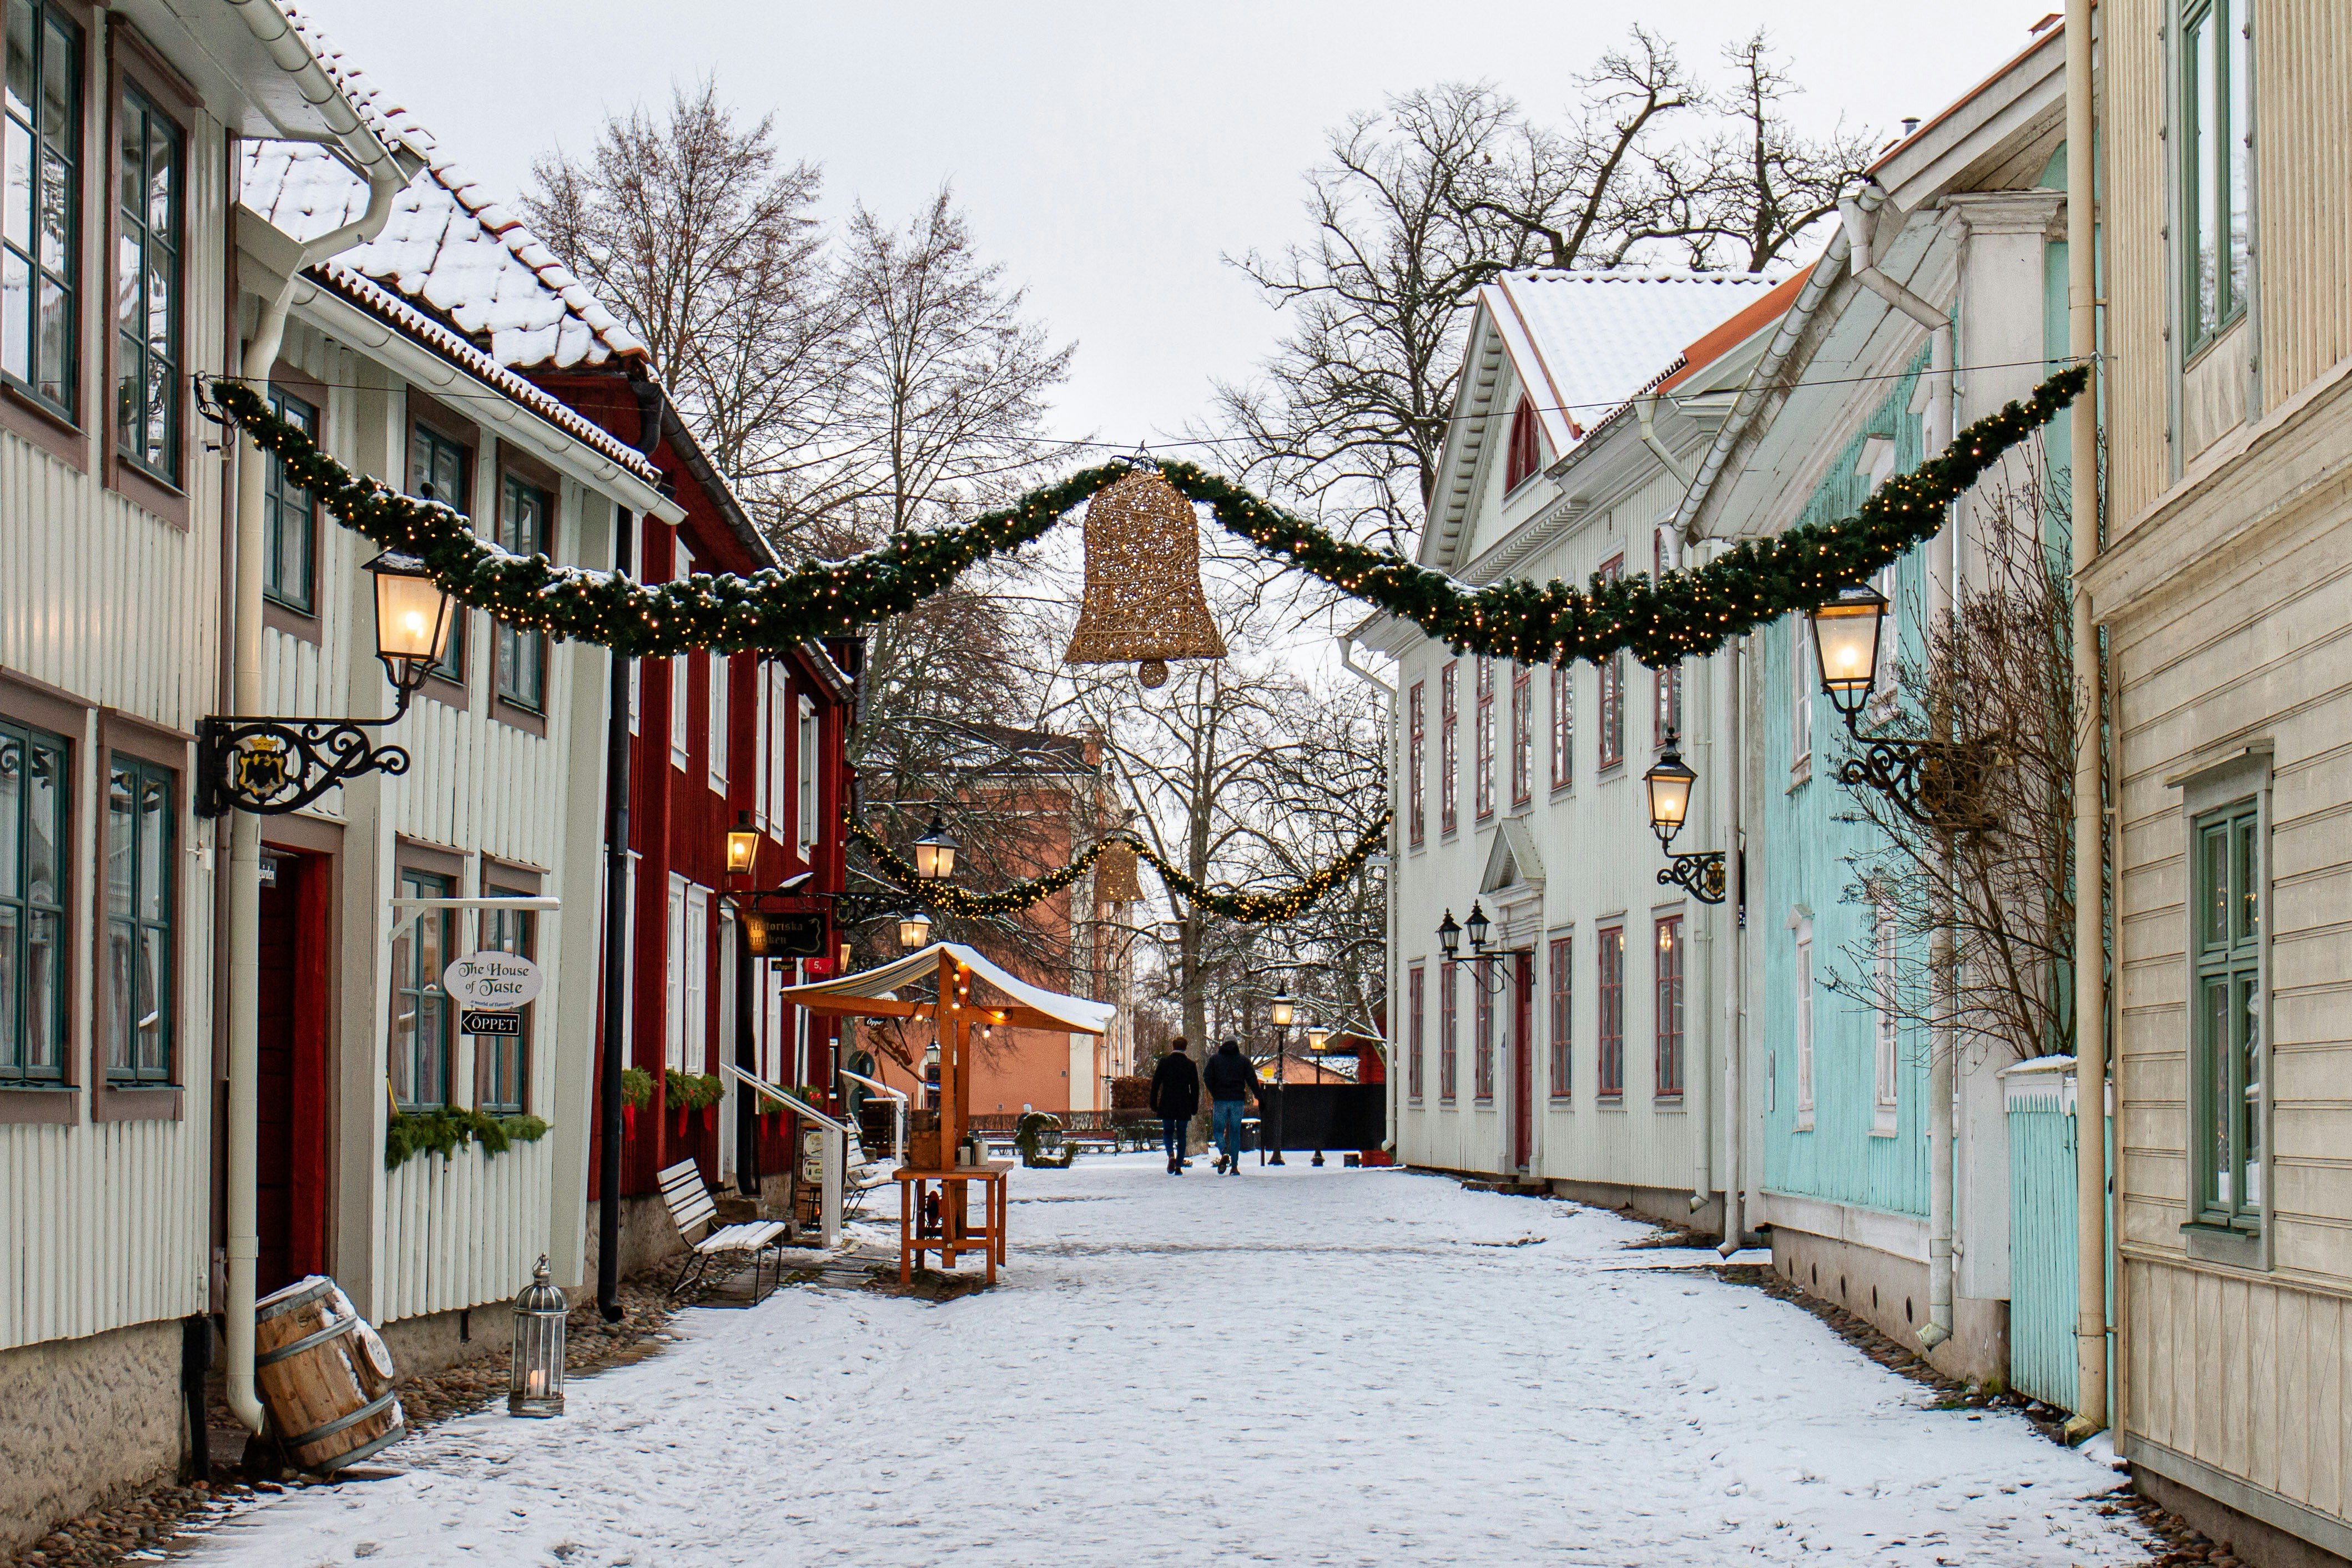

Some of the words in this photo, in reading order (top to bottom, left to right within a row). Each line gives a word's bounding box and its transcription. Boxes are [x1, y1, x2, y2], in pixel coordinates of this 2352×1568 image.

[459, 962, 484, 977] The
[487, 963, 529, 976] House
[465, 981, 476, 994] of
[479, 979, 522, 996] Taste
[472, 1016, 516, 1031] ÖPPET
